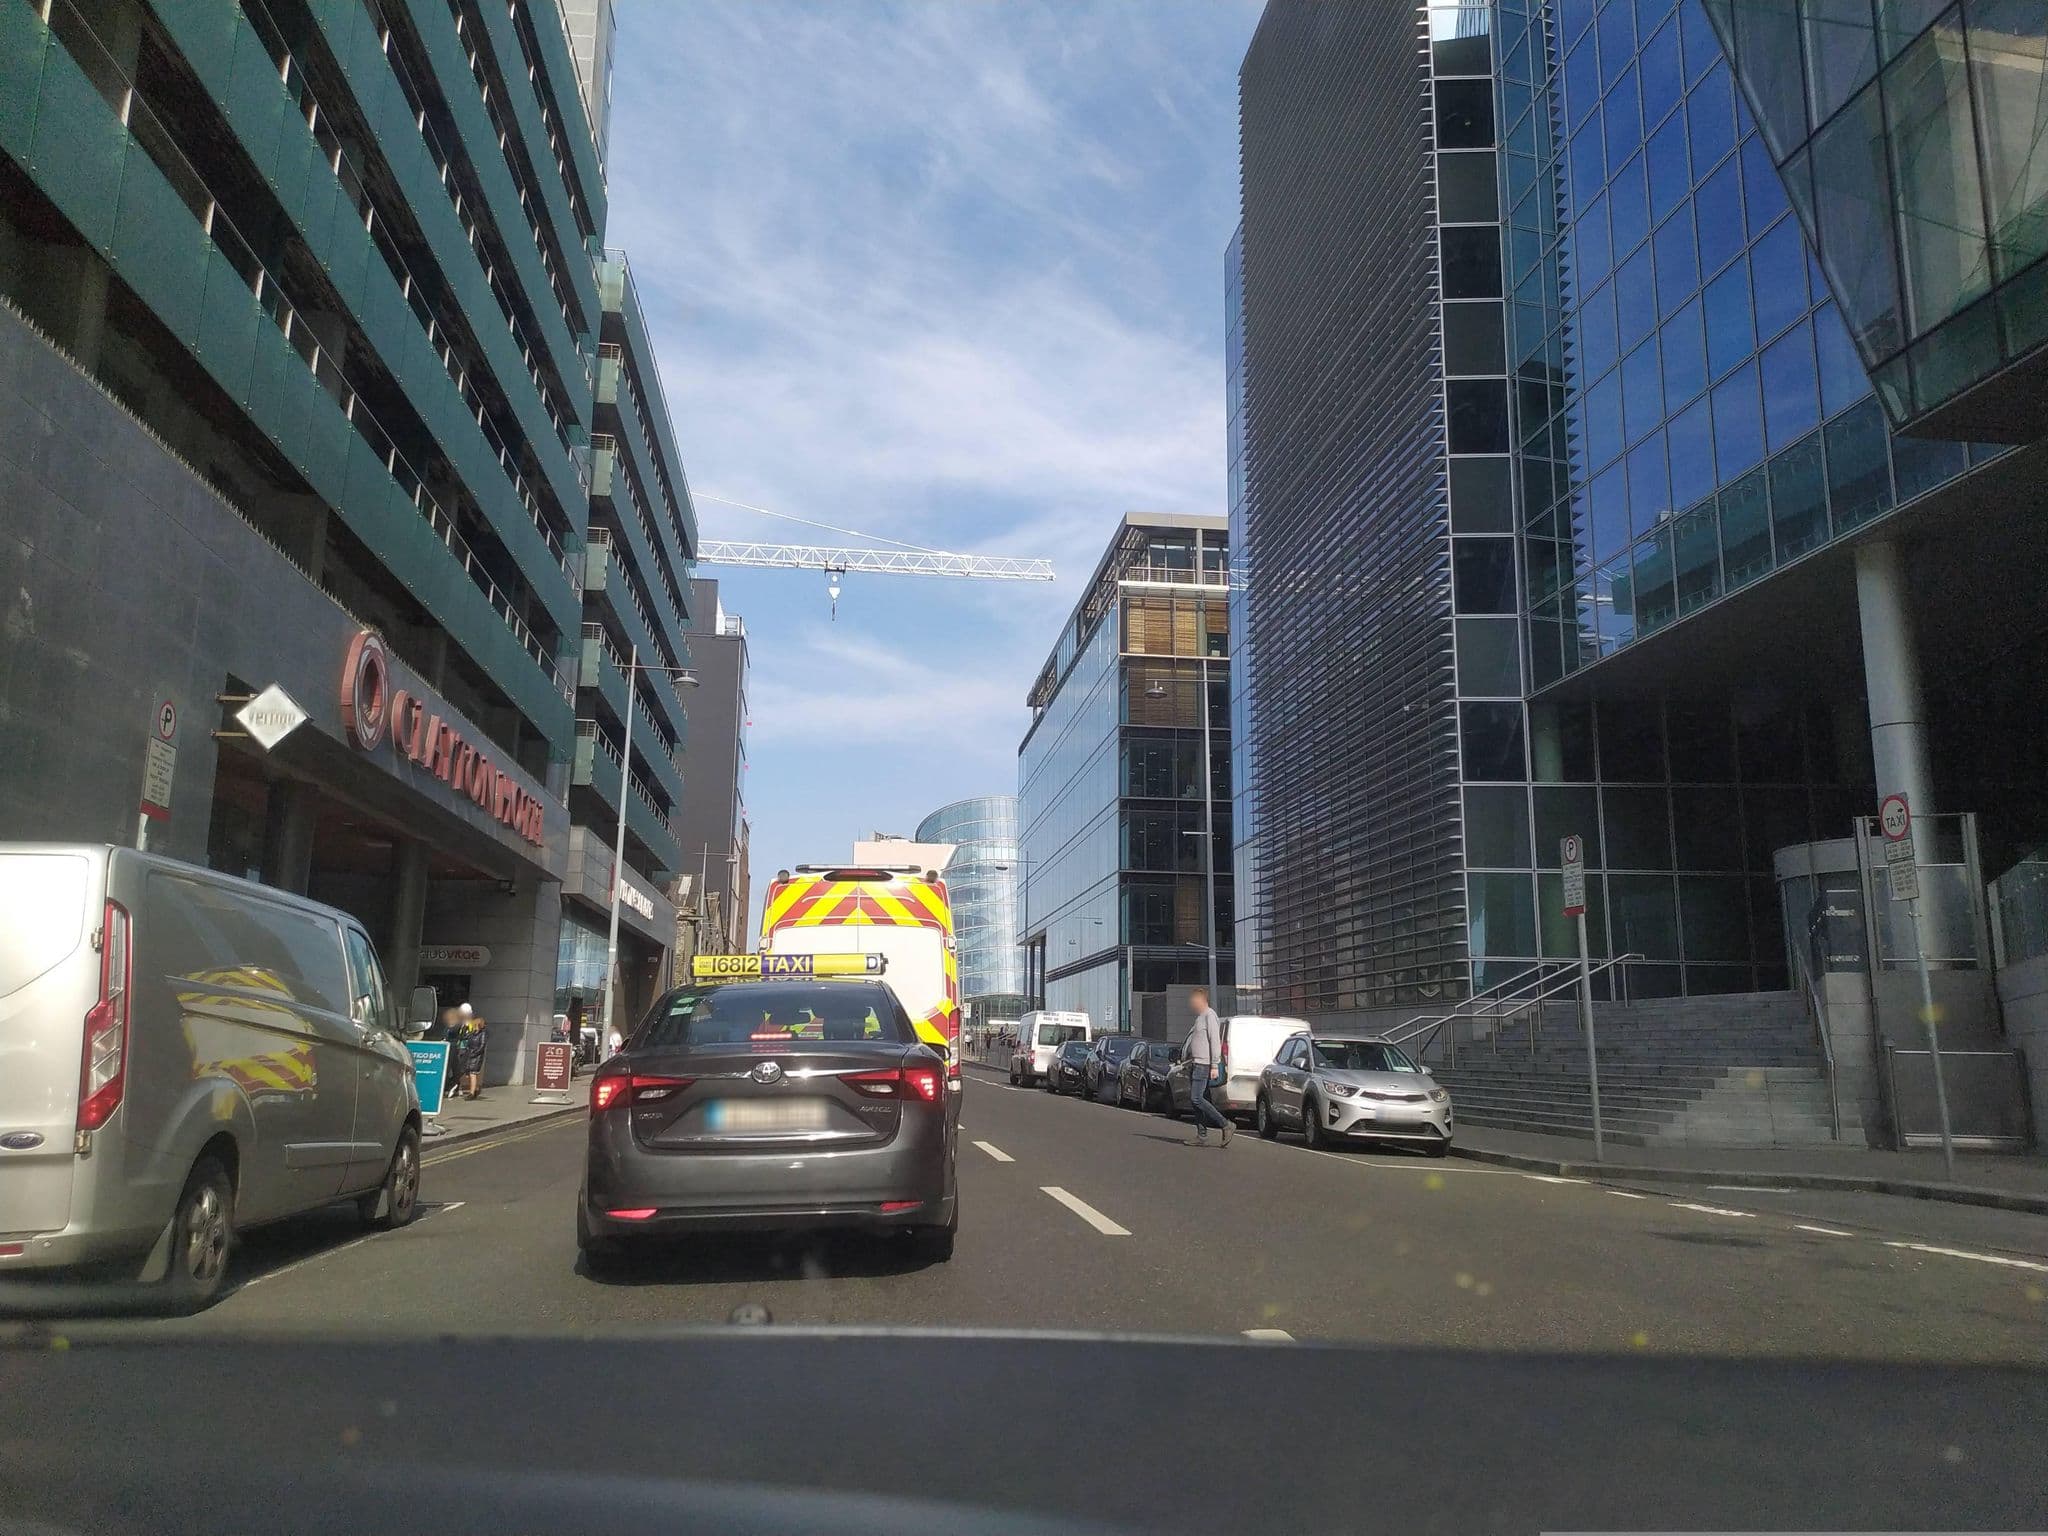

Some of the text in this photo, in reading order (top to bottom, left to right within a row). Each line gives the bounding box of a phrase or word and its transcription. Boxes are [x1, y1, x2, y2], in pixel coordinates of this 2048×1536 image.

[391, 689, 544, 846] CLAYTON HOTEL
[1886, 814, 1906, 829] TAXI
[711, 956, 760, 974] 16812
[763, 955, 811, 973] TAXI
[866, 955, 879, 971] D
[429, 1052, 442, 1060] BAR
